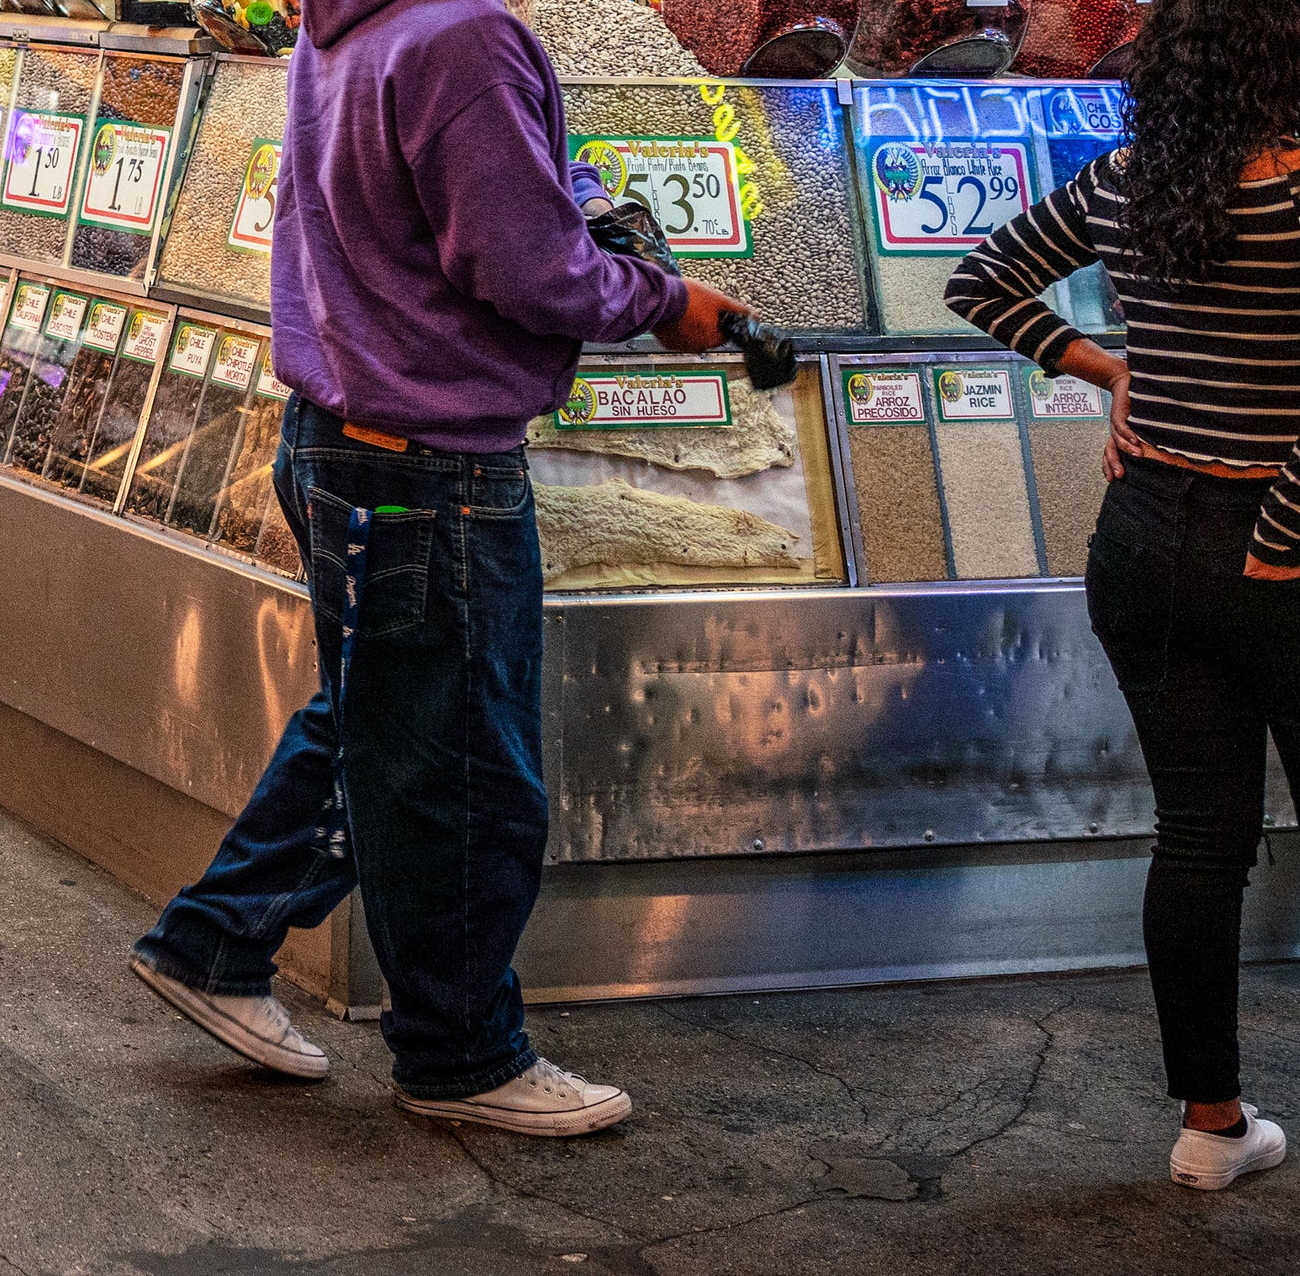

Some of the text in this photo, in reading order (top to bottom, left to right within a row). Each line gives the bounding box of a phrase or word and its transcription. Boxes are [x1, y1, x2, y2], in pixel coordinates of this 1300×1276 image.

[1086, 102, 1118, 114] CHILE
[1088, 113, 1123, 129] COS
[626, 139, 710, 159] Valeria's
[922, 141, 1003, 160] Valeria's
[25, 297, 41, 310] CHILE
[62, 307, 78, 320] CHILE
[101, 313, 118, 326] CHILE
[137, 334, 157, 347] GHOST
[189, 336, 206, 350] CHILE
[133, 344, 155, 358] PEPPER
[231, 345, 248, 359] CHILE
[187, 352, 203, 366] PUYA
[225, 355, 253, 373] CHIPOTLE
[224, 368, 247, 384] MORITA
[614, 375, 685, 390] Valeria's
[963, 384, 1003, 397] JAZMIN
[598, 389, 687, 406] BACALAO
[875, 396, 911, 408] ARROZ
[968, 396, 997, 409] RICE
[1052, 392, 1089, 404] ARROZ
[611, 404, 677, 417] SIN HUESO
[857, 406, 919, 419] PRECOSIDO
[1045, 403, 1097, 415] INTEGRAL
